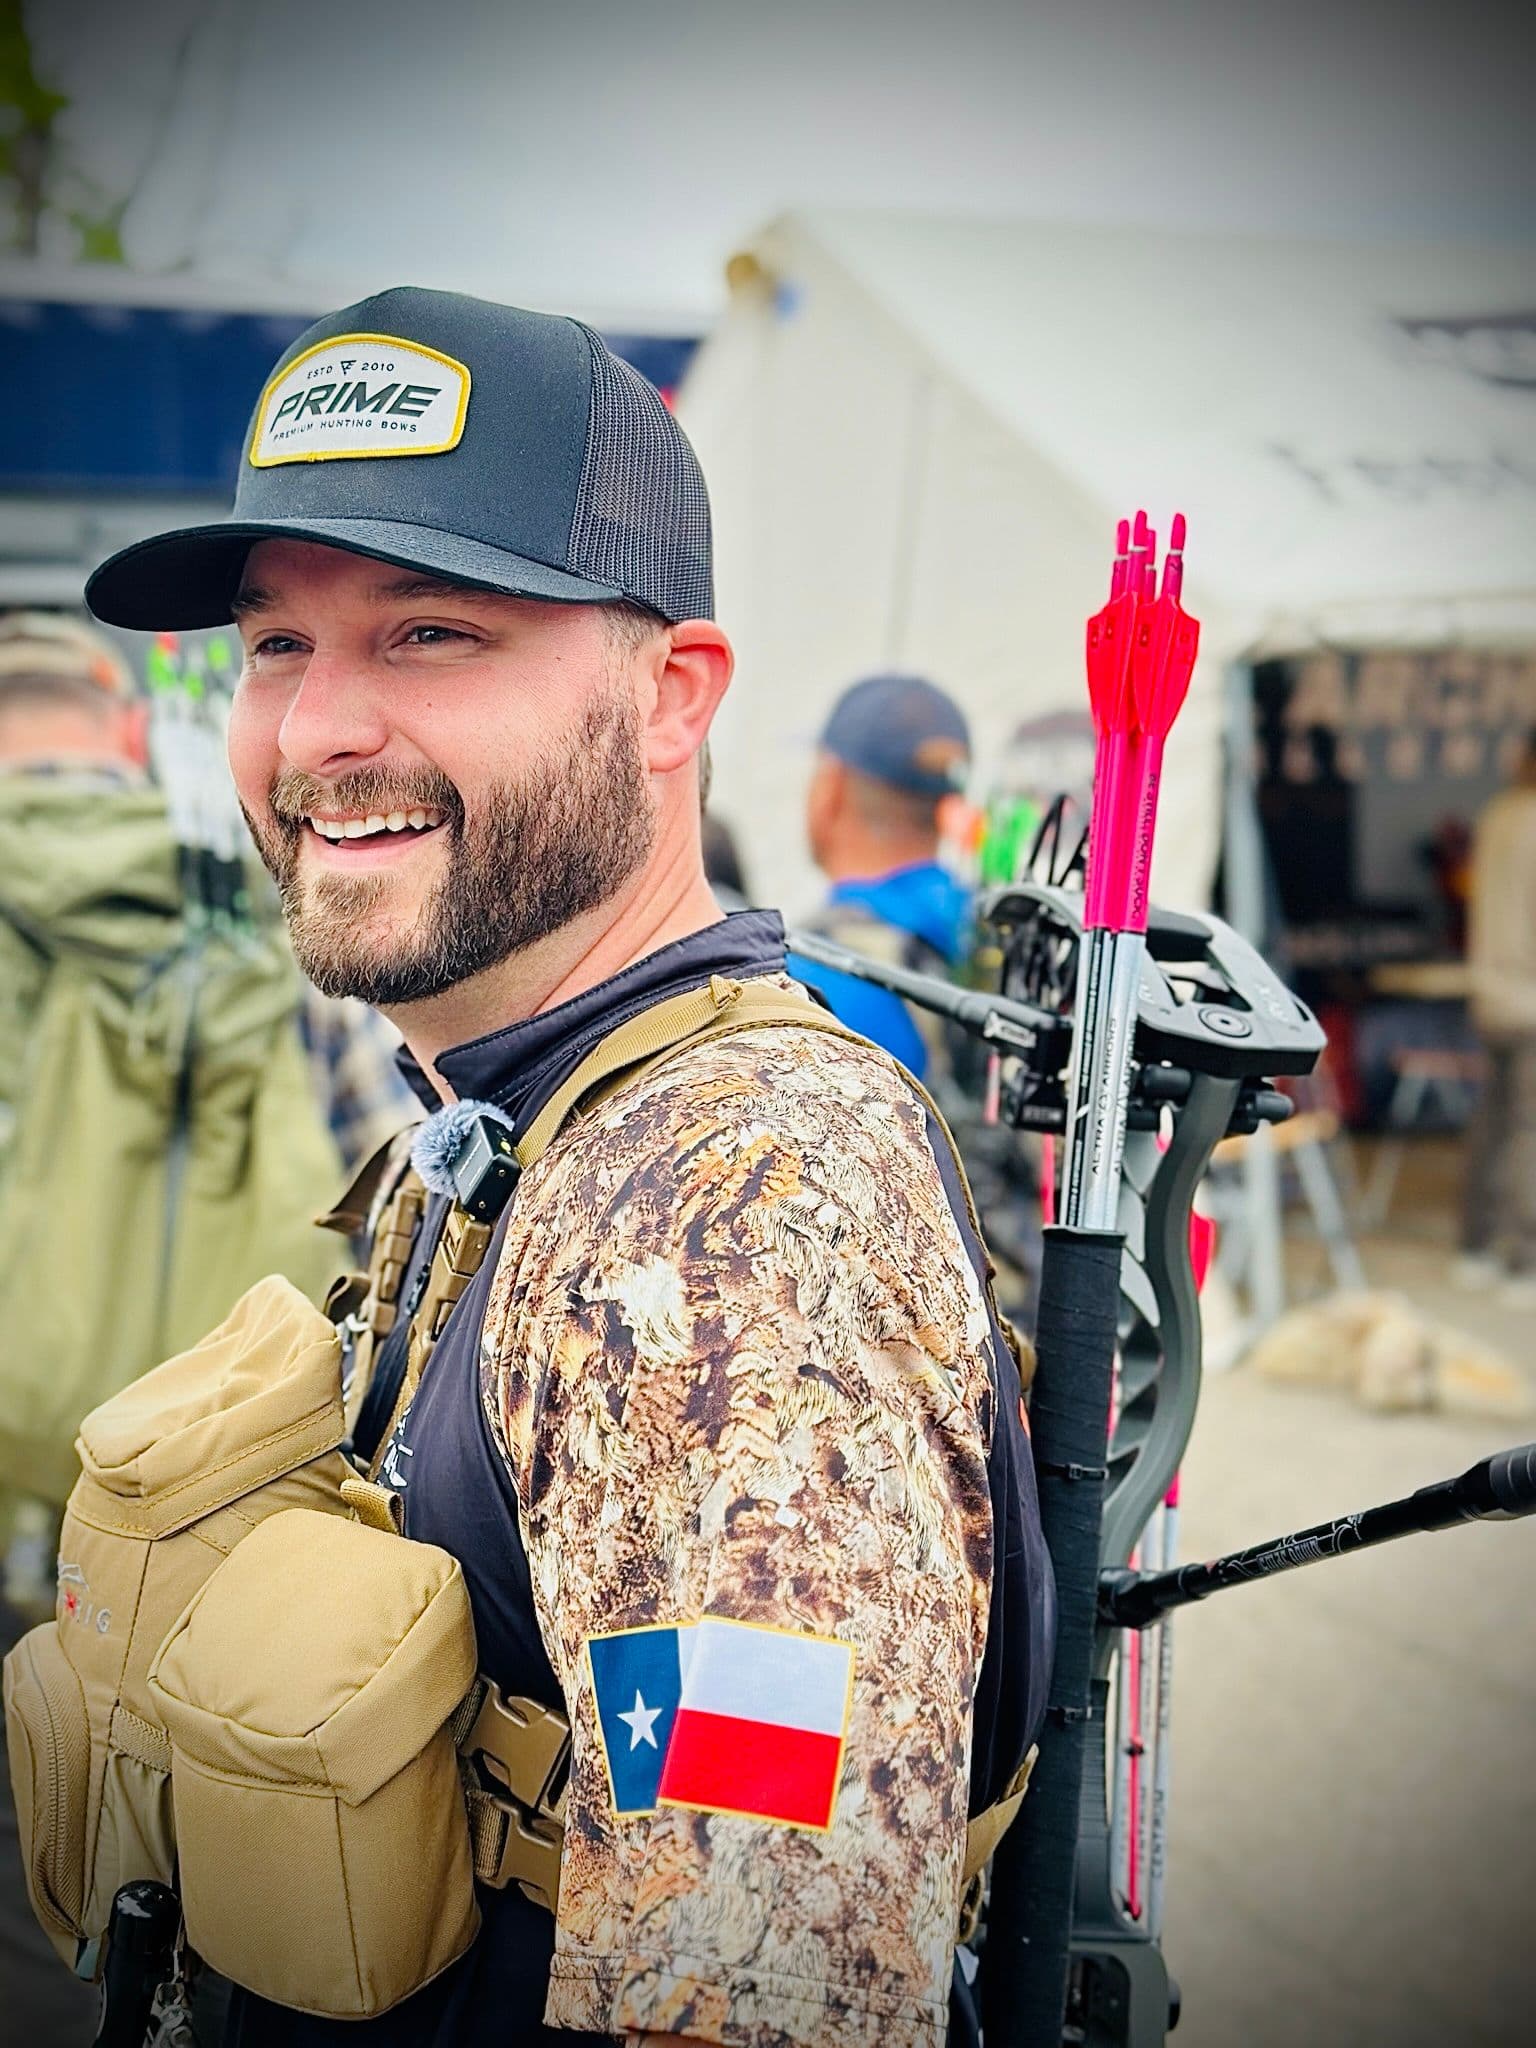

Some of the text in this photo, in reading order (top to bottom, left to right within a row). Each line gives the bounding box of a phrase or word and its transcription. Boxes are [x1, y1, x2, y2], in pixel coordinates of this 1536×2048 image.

[307, 362, 395, 379] ESTD 2010
[269, 381, 443, 434] PRIME
[273, 419, 417, 442] PREMIUM HUNTING BOWS
